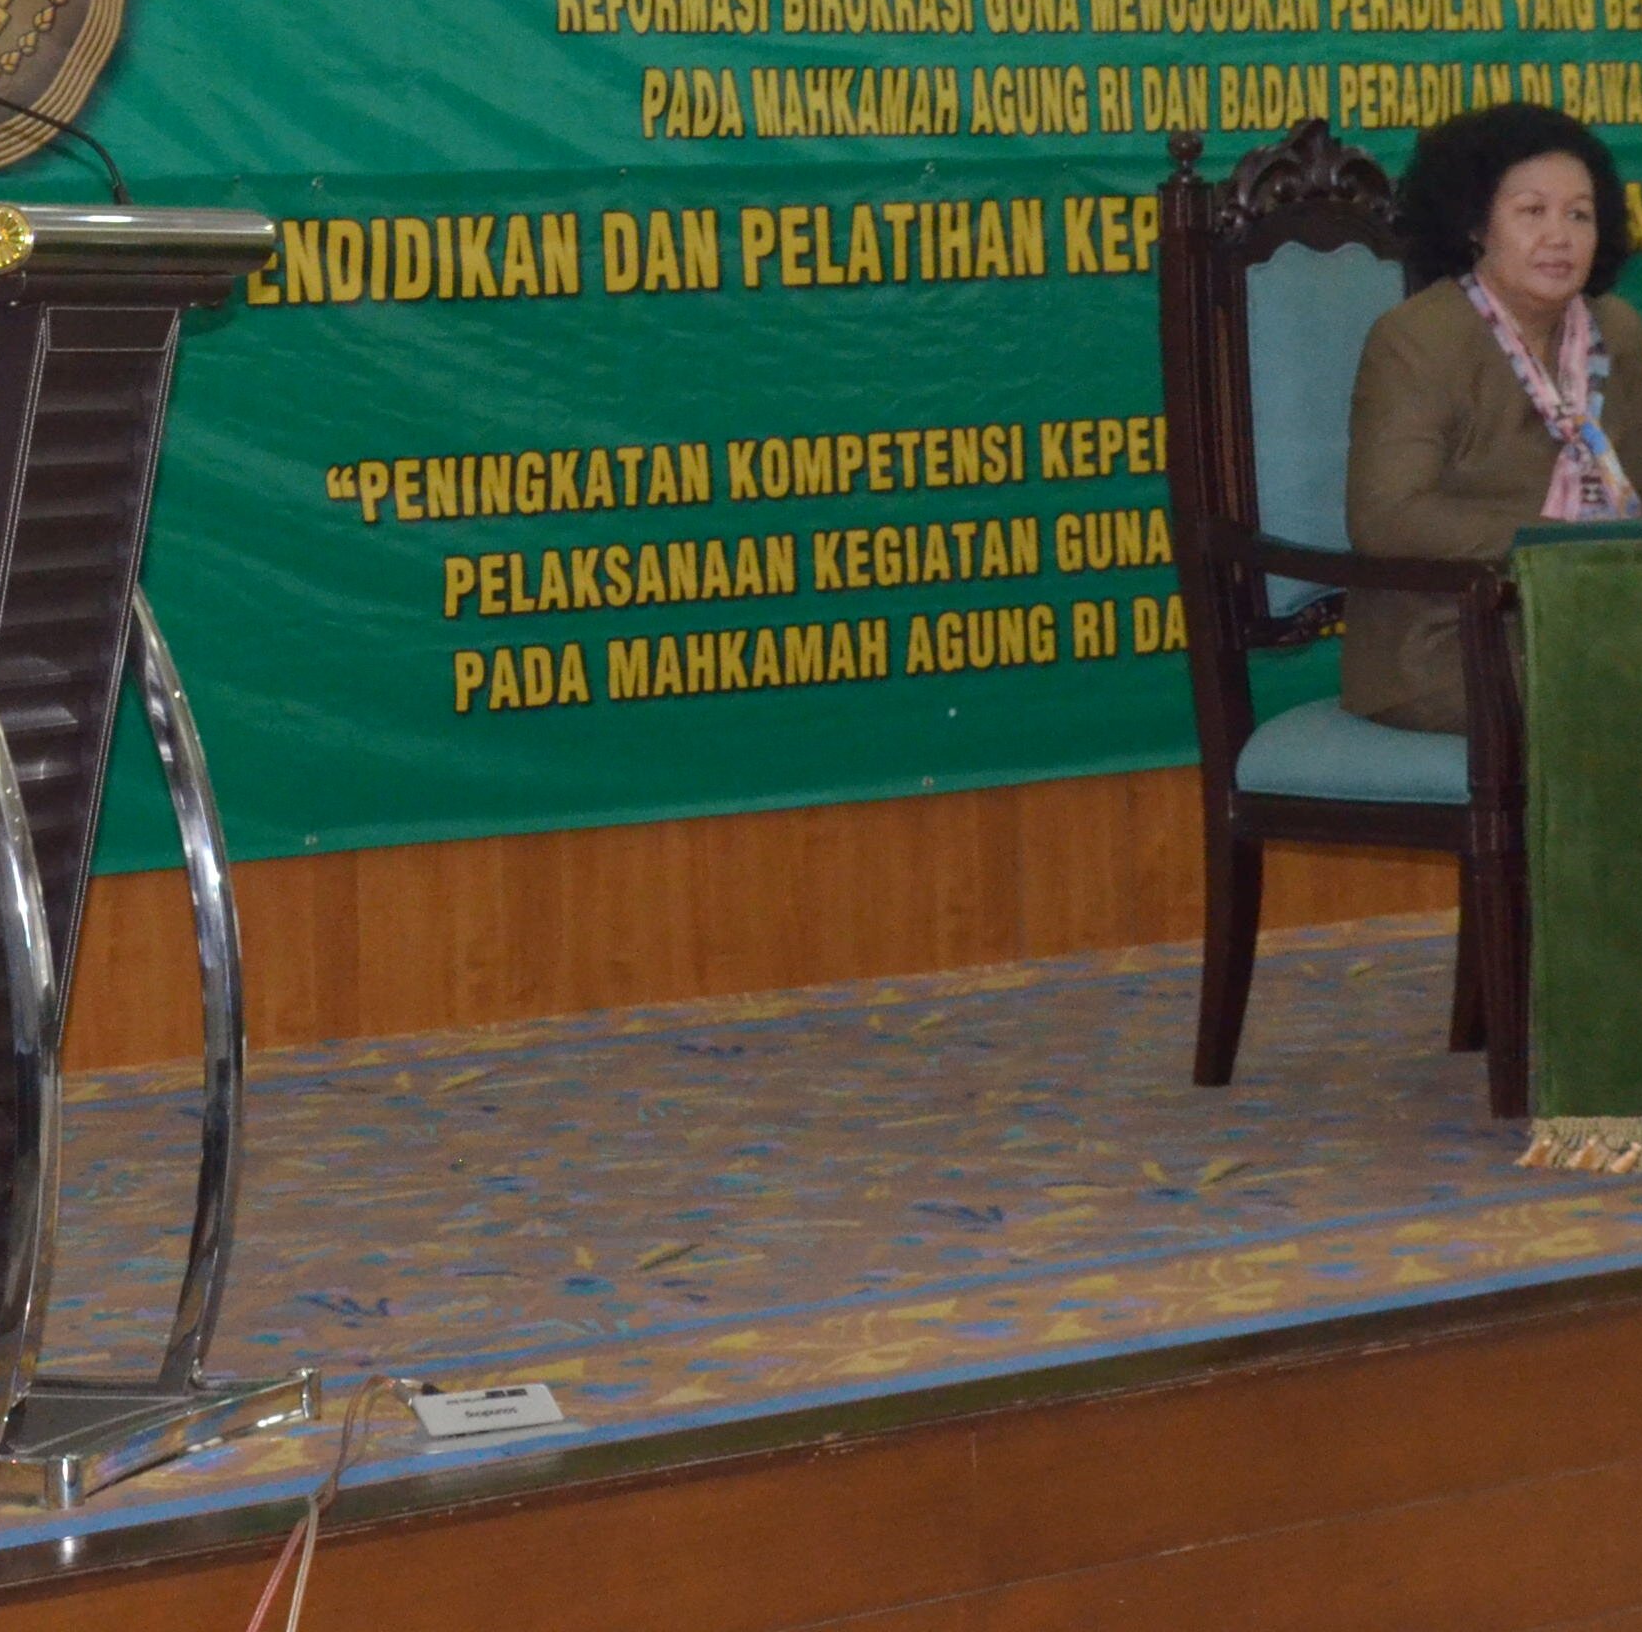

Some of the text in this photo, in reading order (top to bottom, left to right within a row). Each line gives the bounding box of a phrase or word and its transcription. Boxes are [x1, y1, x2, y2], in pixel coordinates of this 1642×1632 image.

[641, 67, 744, 139] PADA
[750, 66, 961, 138] MAHKAMAH
[969, 64, 1090, 137] AGUNG
[1097, 65, 1134, 133] RI
[1141, 64, 1209, 133] DAN
[1219, 63, 1330, 132] BADAN
[1338, 62, 1514, 130] PERADILAN
[1519, 62, 1554, 109] DI
[602, 208, 720, 294] DAN
[739, 197, 1046, 288] PELATIHAN
[1063, 194, 1161, 275] KEP
[726, 423, 1025, 501] KOMPETENSI
[443, 507, 1174, 618] PELAKSANAAN KEGIATAN GUNA
[453, 642, 591, 713] PADA
[607, 618, 888, 700] MAHKAMAH
[905, 603, 1057, 675] AGUNG
[1072, 599, 1117, 659] RI
